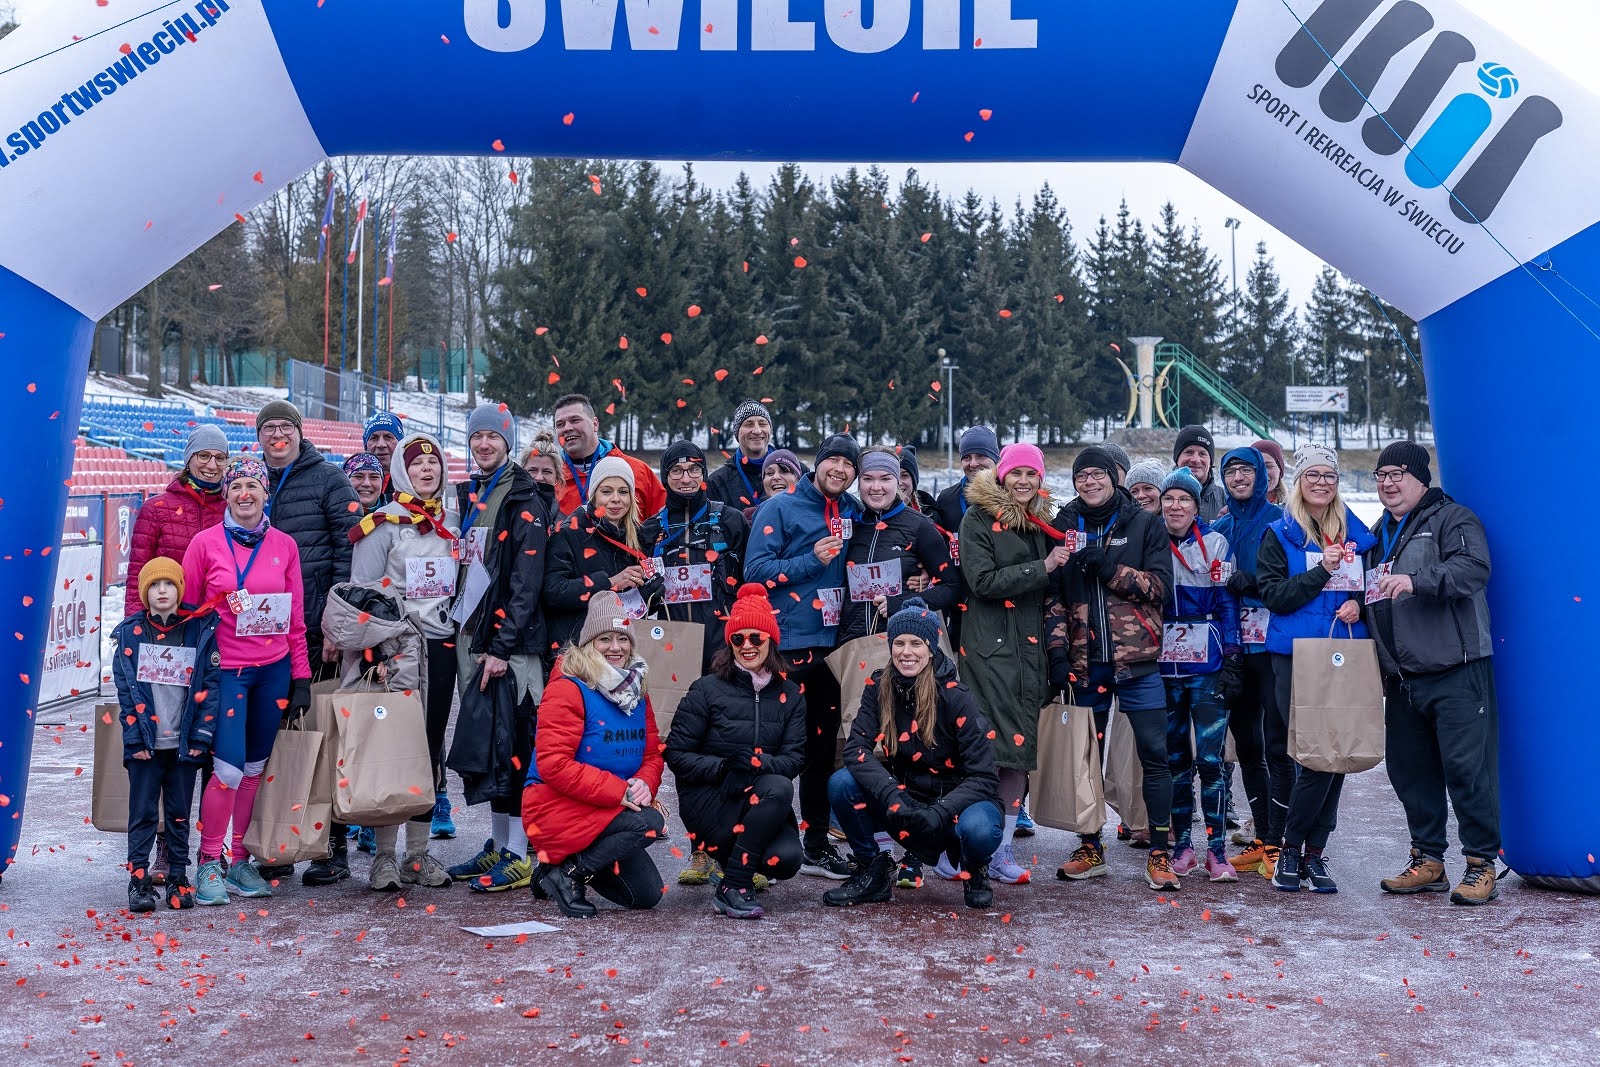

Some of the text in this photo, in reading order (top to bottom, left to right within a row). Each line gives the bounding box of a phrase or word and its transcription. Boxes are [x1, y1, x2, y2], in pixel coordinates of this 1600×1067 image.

[1247, 84, 1465, 254] SPORT I REKREACJA W ŚWIECIU
[469, 529, 476, 543] 5
[425, 561, 436, 577] 5
[678, 567, 689, 581] 8
[867, 566, 881, 579] 11
[258, 597, 271, 614] 4
[50, 588, 86, 642] iecie
[1175, 627, 1187, 642] 2
[160, 647, 173, 662] 4
[603, 728, 645, 743] RHINO
